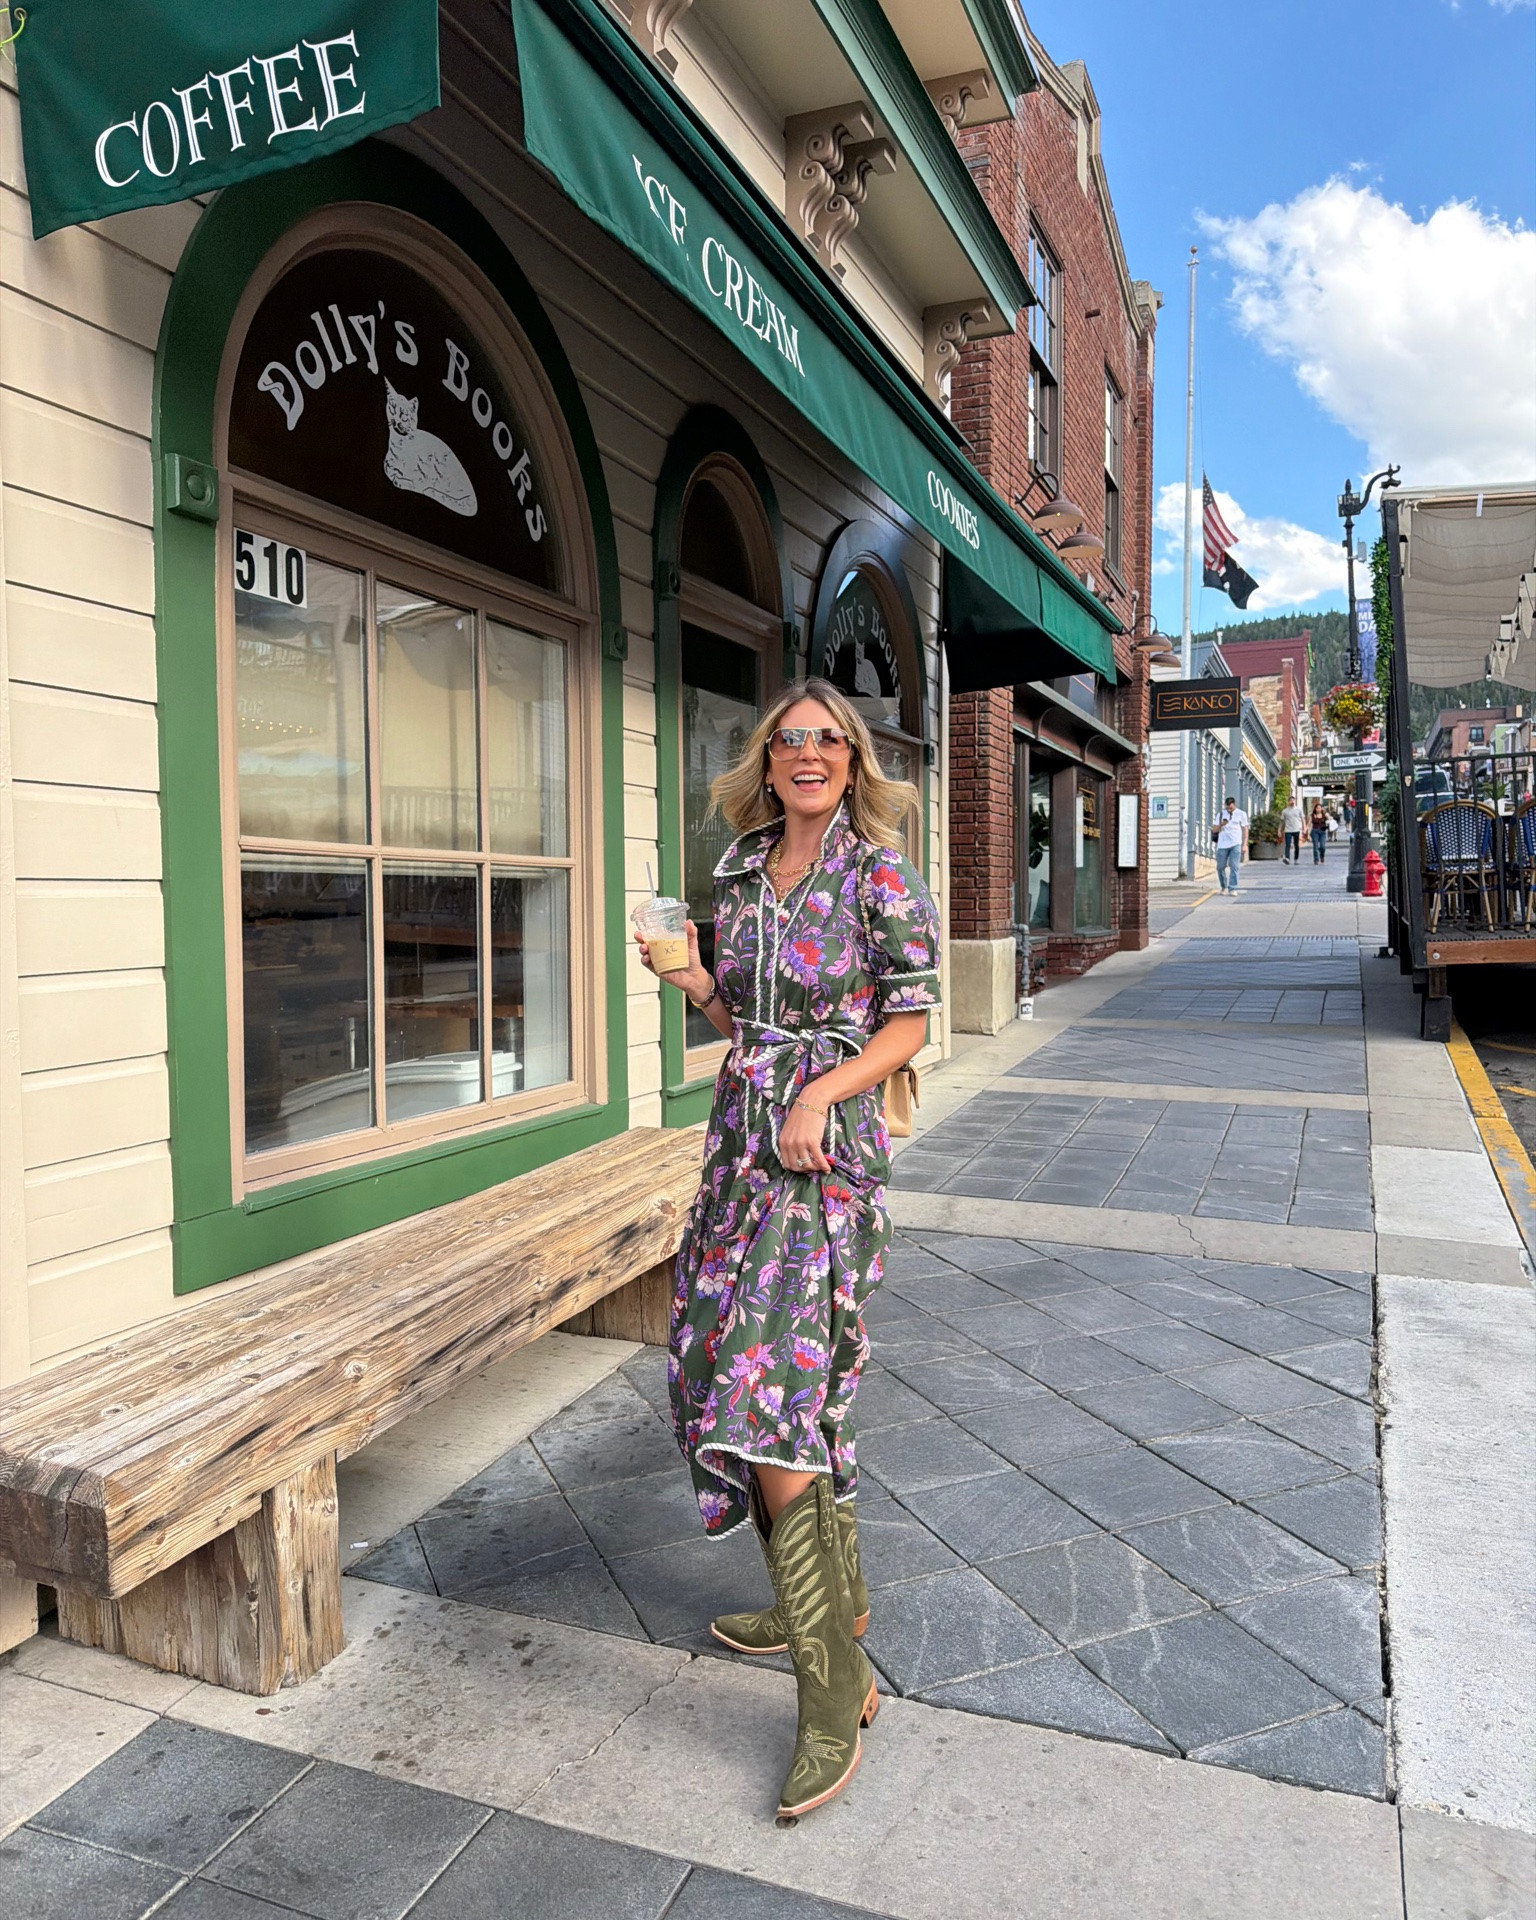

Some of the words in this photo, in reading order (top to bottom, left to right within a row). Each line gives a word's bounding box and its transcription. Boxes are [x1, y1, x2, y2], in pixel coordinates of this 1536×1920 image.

[95, 29, 366, 188] COFFEE
[702, 237, 805, 377] CREAM
[256, 300, 418, 431] Dolly's
[928, 470, 980, 550] COOKIES
[235, 532, 304, 606] 510
[825, 597, 865, 676] Dolly's
[1183, 694, 1232, 711] KANEO
[1335, 758, 1350, 766] ONE
